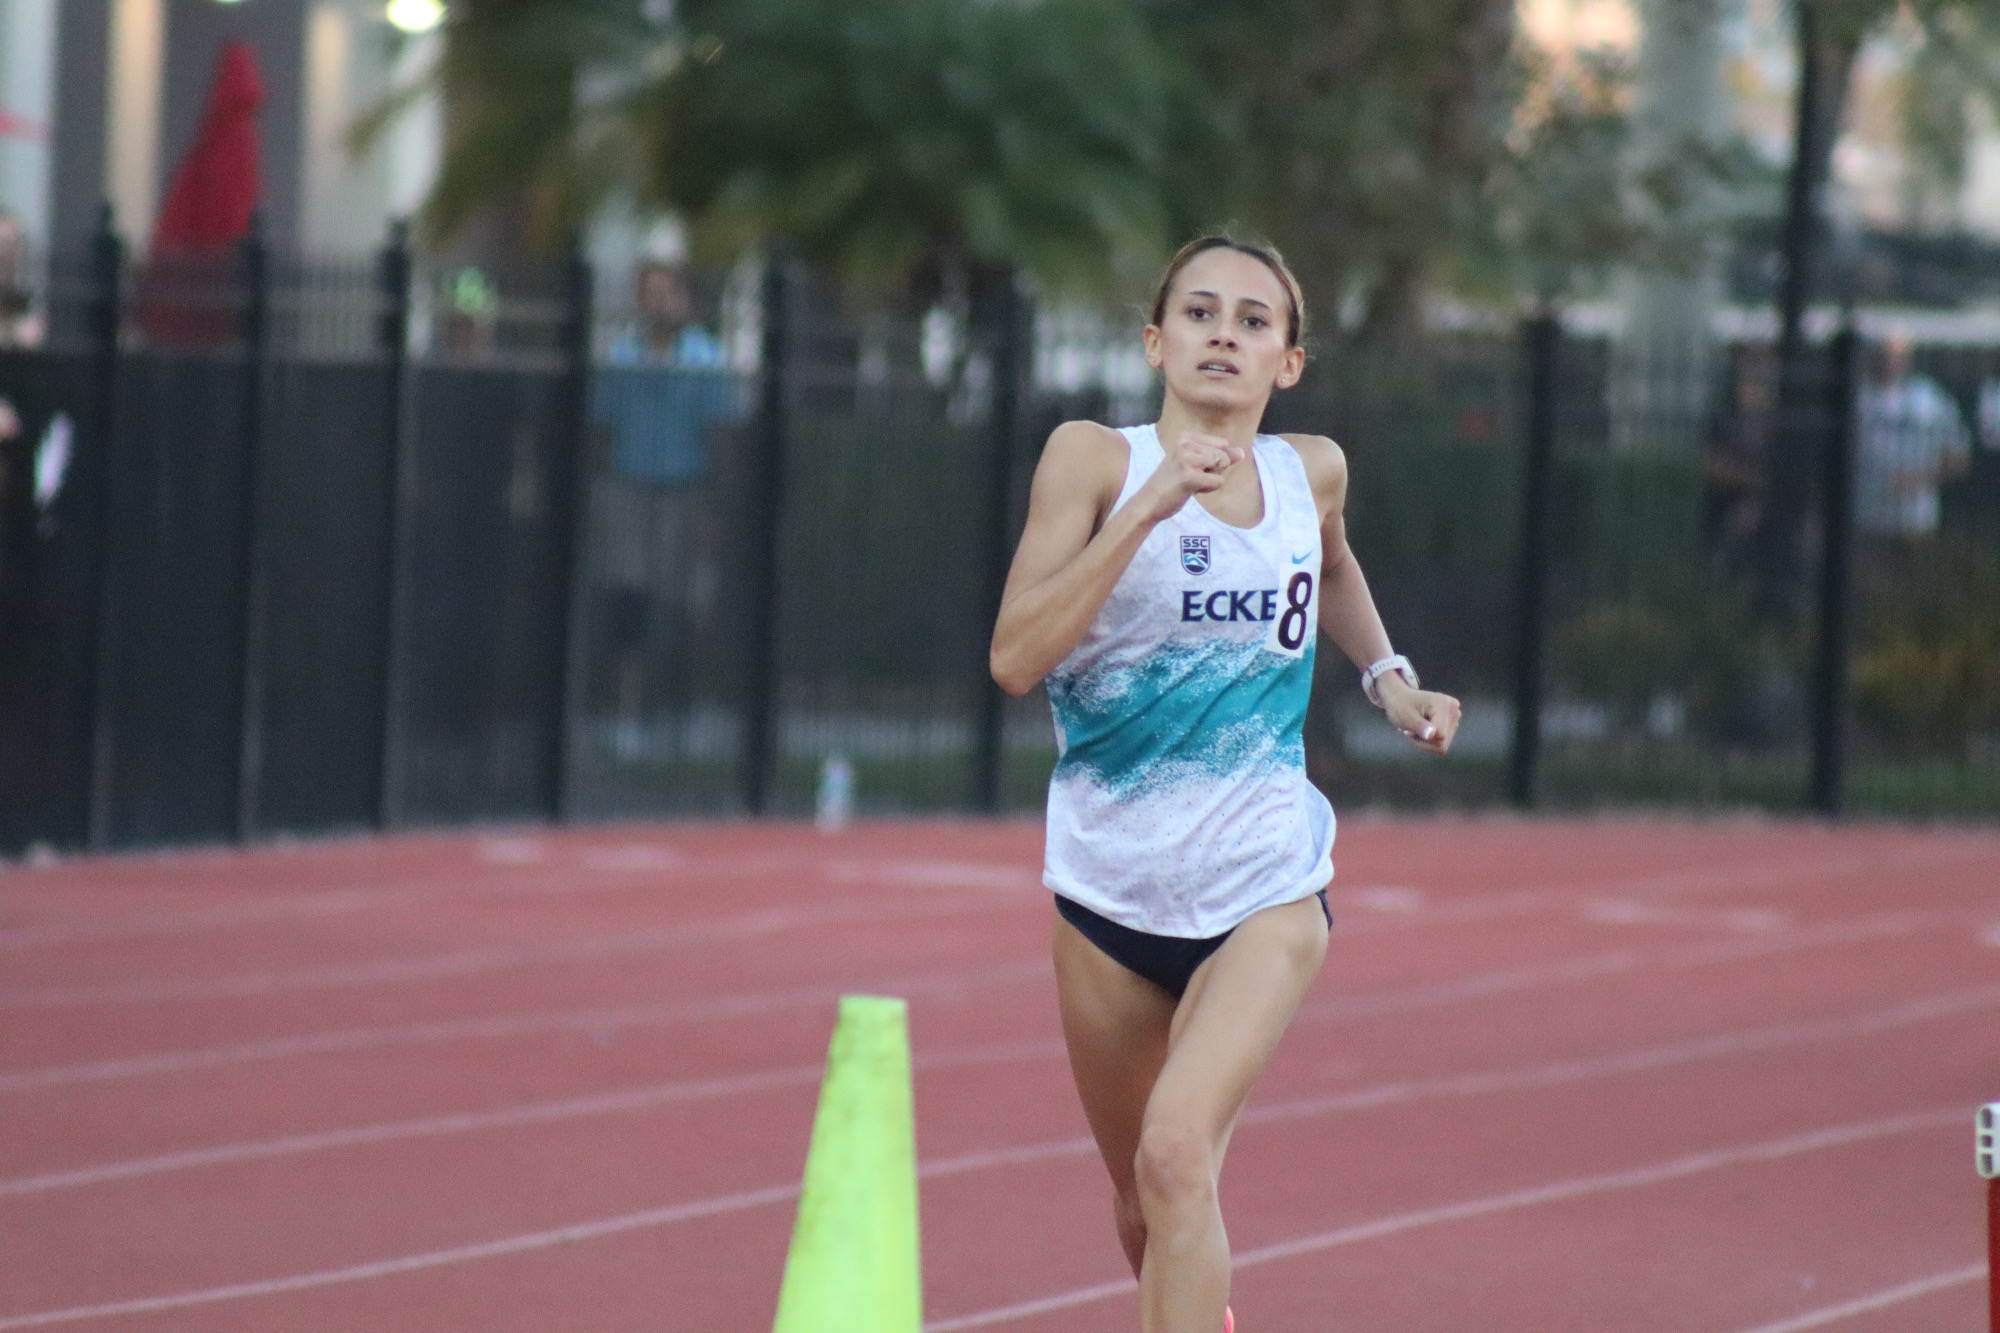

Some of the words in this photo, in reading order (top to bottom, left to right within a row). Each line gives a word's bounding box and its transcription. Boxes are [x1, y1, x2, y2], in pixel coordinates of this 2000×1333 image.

[1183, 538, 1207, 547] SSC
[1181, 590, 1278, 622] ECKE
[1278, 571, 1312, 650] 8
